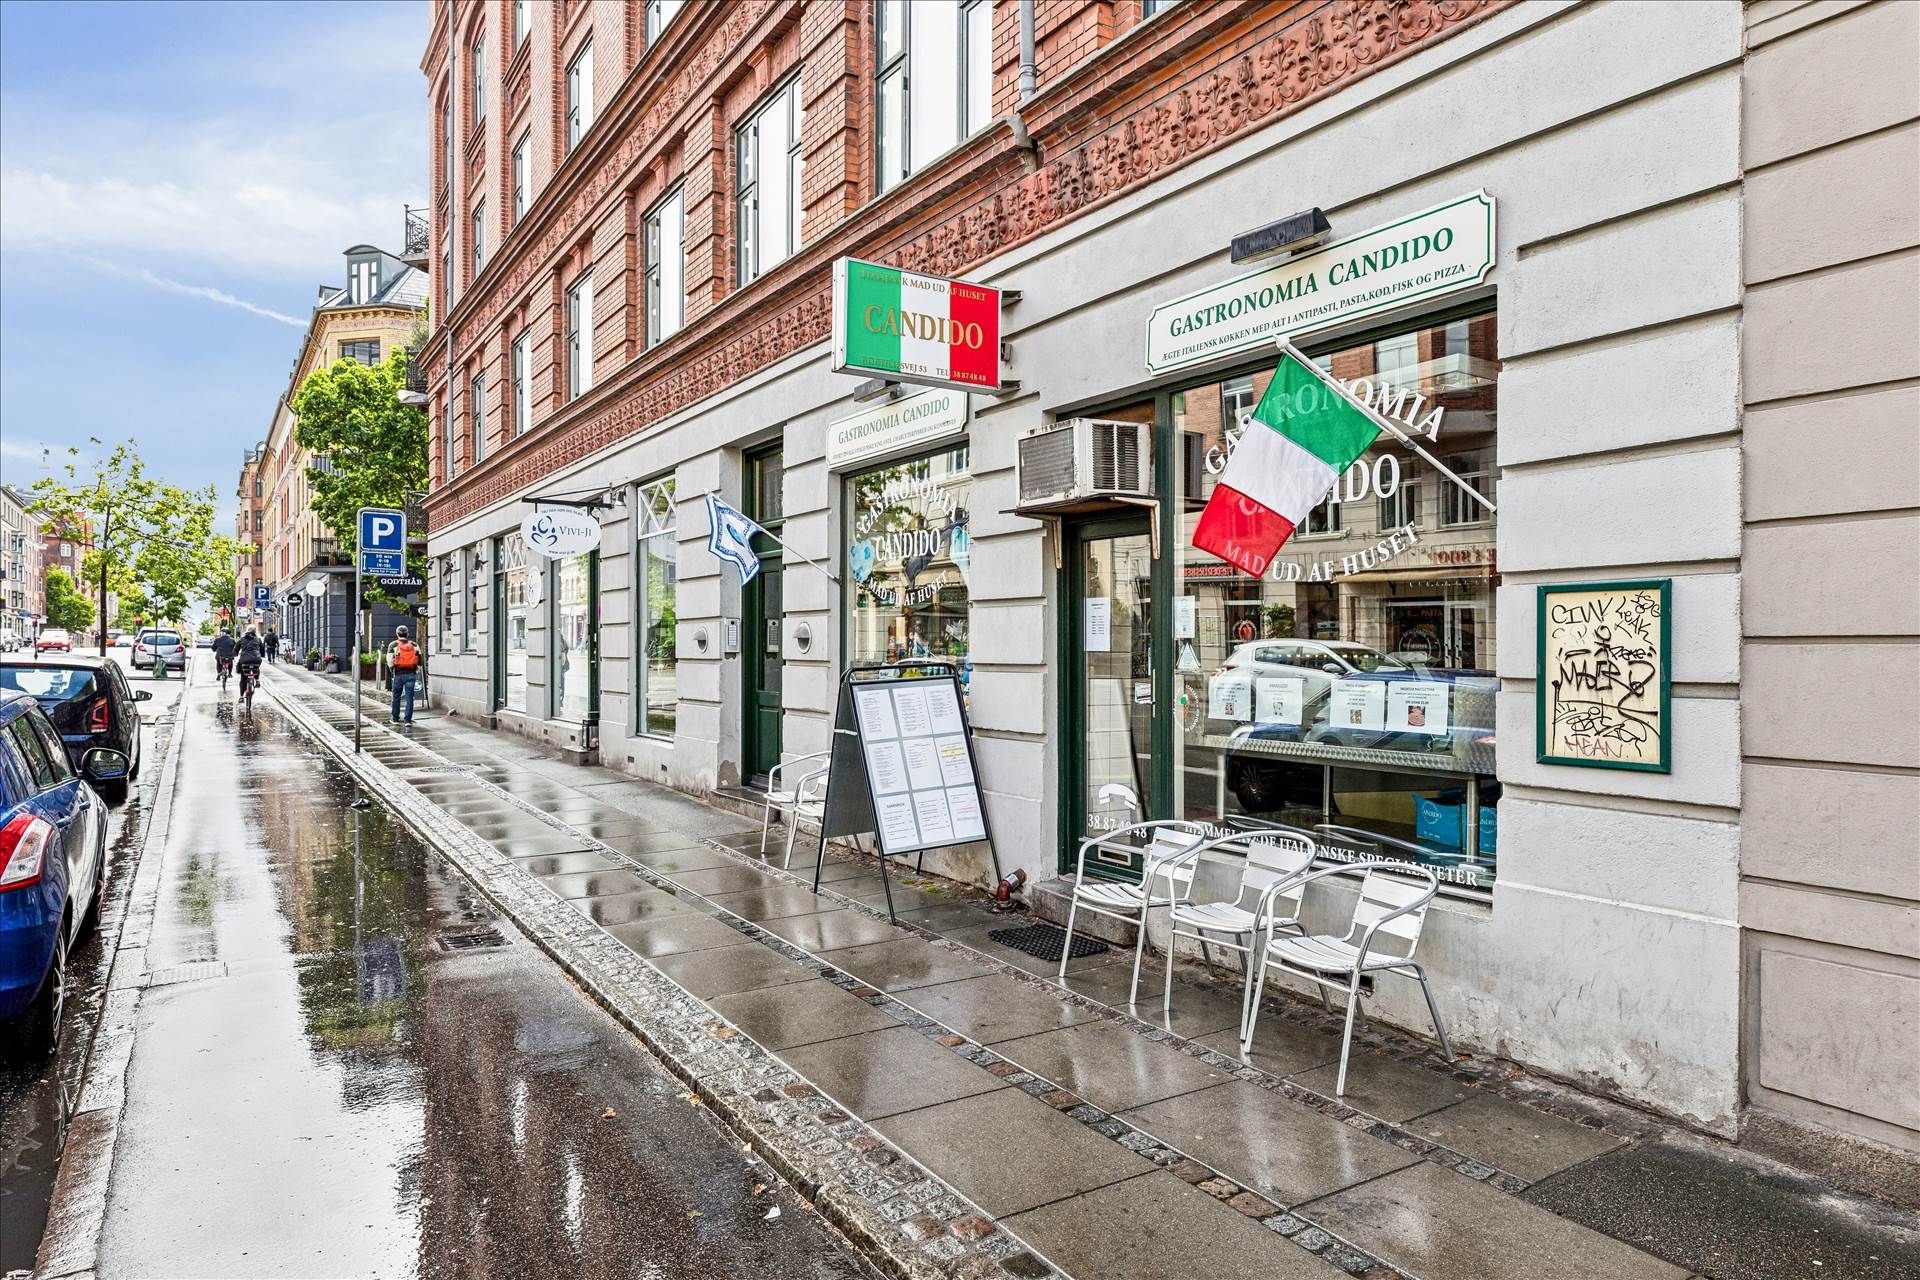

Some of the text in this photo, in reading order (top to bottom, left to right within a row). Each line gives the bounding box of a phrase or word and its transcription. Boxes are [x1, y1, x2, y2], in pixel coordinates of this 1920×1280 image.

[909, 280, 931, 290] MAD
[932, 283, 946, 292] UD
[959, 288, 987, 301] HUSET
[1170, 227, 1455, 338] GASTRONOMIA CANDIDO
[864, 305, 984, 350] CANDIDO
[1162, 350, 1181, 361] ÆGTE
[1182, 339, 1218, 356] ITALIENSK
[1219, 329, 1250, 345] KØKKEN
[1251, 322, 1270, 335] MED
[1271, 317, 1286, 329] ALT
[1416, 274, 1432, 285] OG
[1434, 263, 1466, 281] PIZZA
[838, 414, 900, 445] GASTRONOMIA
[903, 396, 950, 424] CANDIDO
[372, 517, 394, 546] P
[875, 527, 941, 562] CANDIDO
[1272, 561, 1300, 582] UD
[1308, 560, 1337, 583] AF
[1341, 521, 1421, 576] HUSET
[258, 588, 267, 599] P
[380, 577, 423, 586] GODTHÅB
[868, 576, 887, 600] MAD
[904, 590, 916, 606] AF
[917, 569, 948, 603] HUSET
[1088, 814, 1100, 828] 38
[1103, 817, 1116, 831] 87
